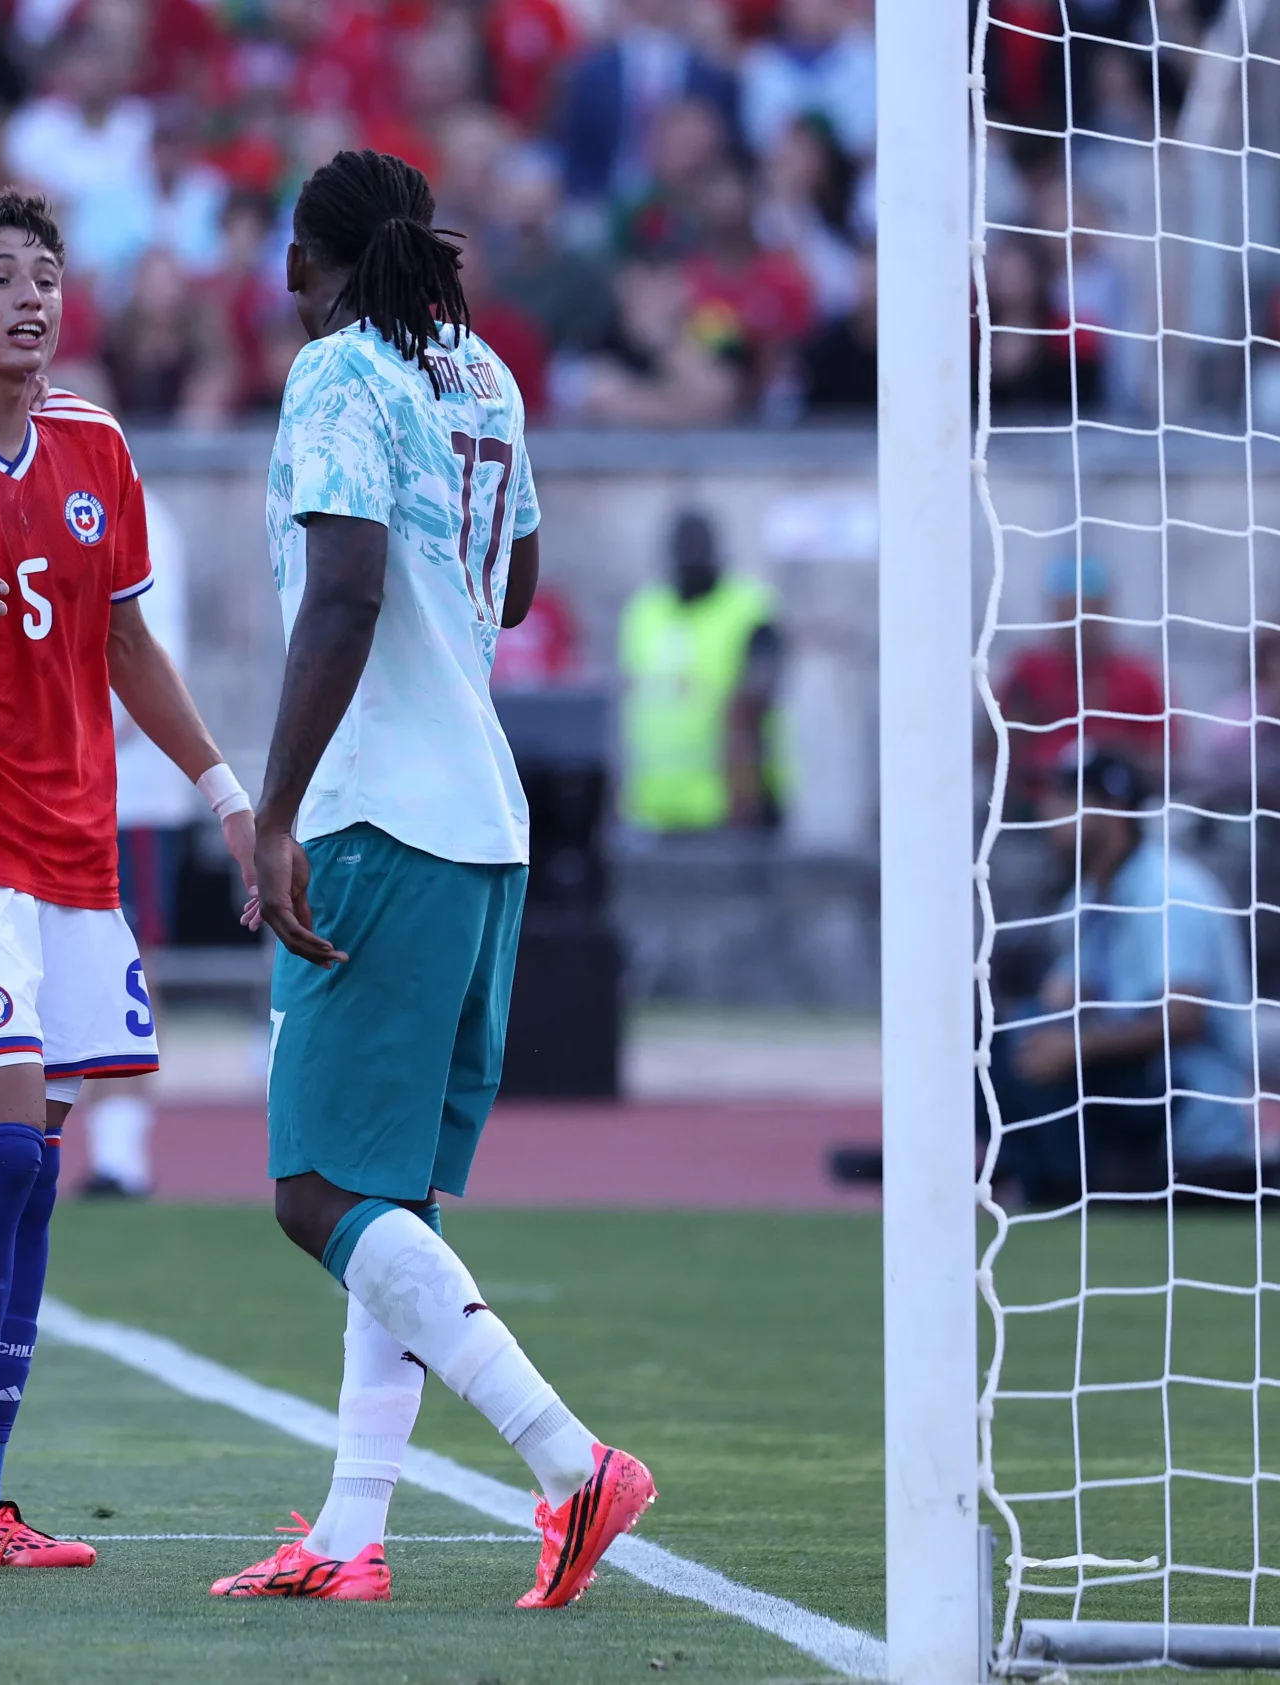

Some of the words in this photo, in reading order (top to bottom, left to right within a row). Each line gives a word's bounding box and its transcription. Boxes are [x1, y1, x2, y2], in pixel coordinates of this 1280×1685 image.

[450, 430, 513, 626] 17
[16, 556, 54, 641] 5
[125, 957, 154, 1038] 5
